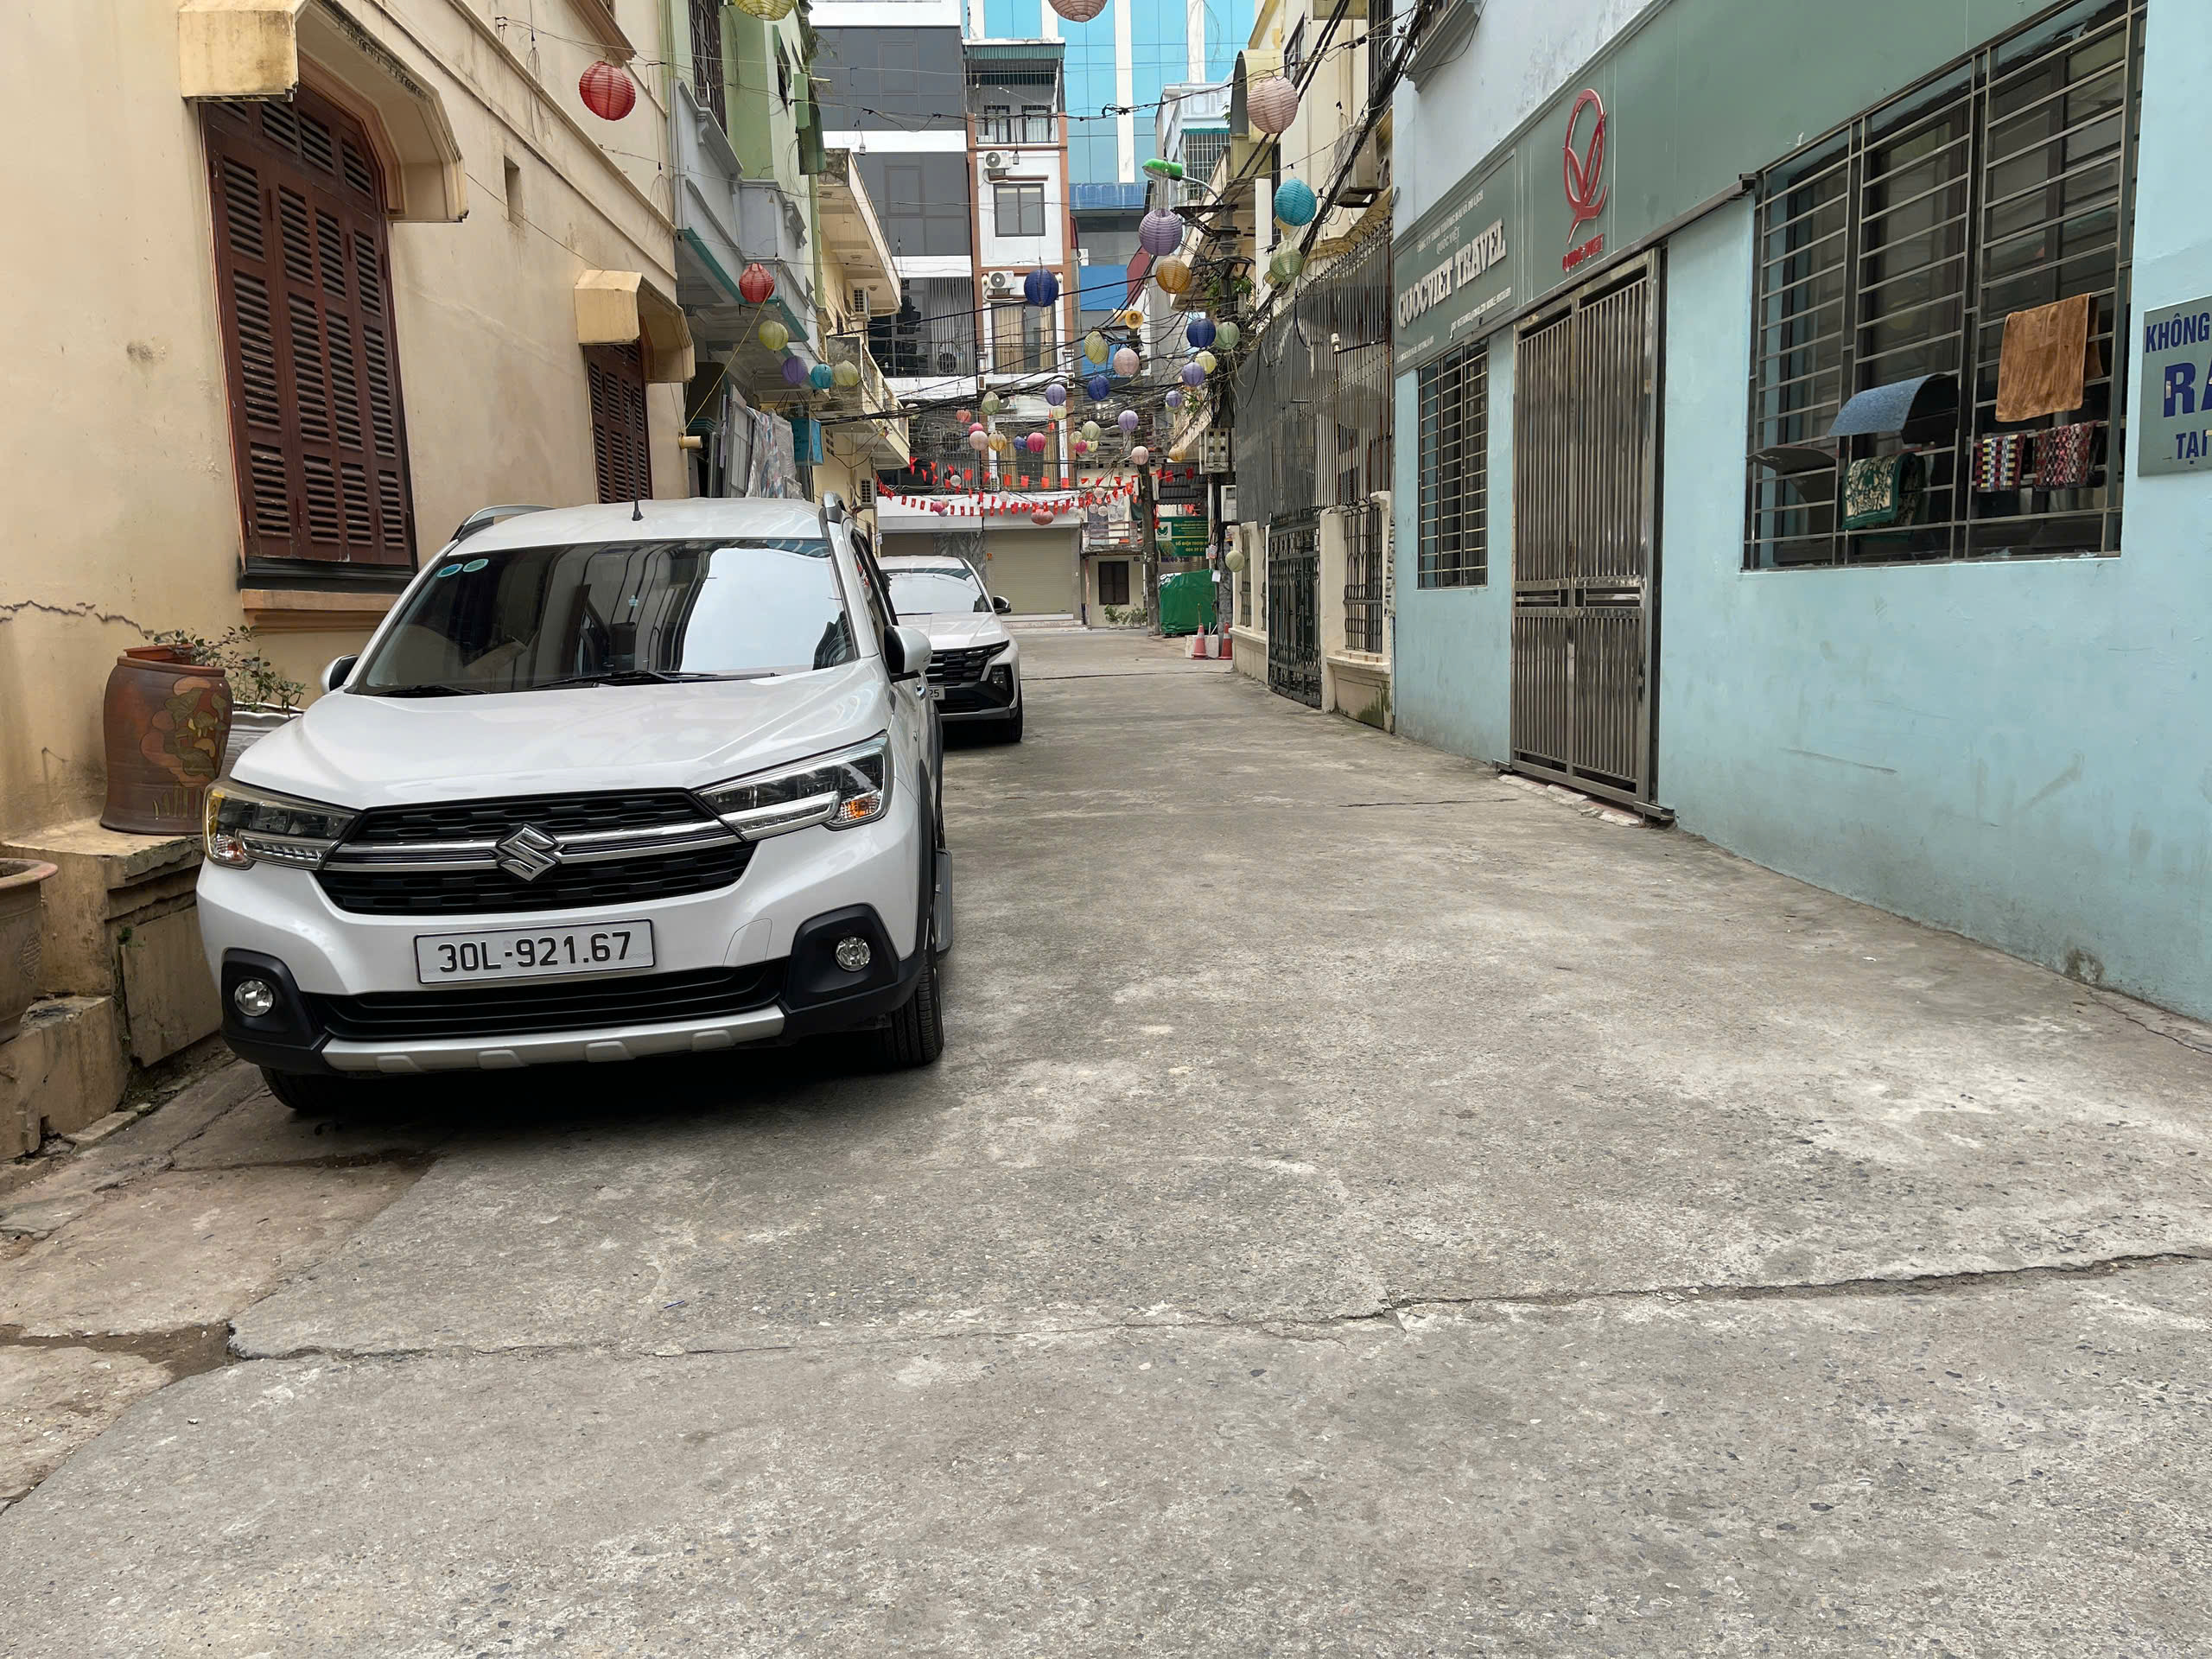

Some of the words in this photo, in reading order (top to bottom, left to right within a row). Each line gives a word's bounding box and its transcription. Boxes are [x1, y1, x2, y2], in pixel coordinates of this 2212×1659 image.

[1398, 257, 1452, 327] QUOCVIET
[1455, 218, 1506, 289] TRAVEL
[2145, 312, 2210, 353] KHÔNG
[437, 931, 631, 972] 30L-921.67
